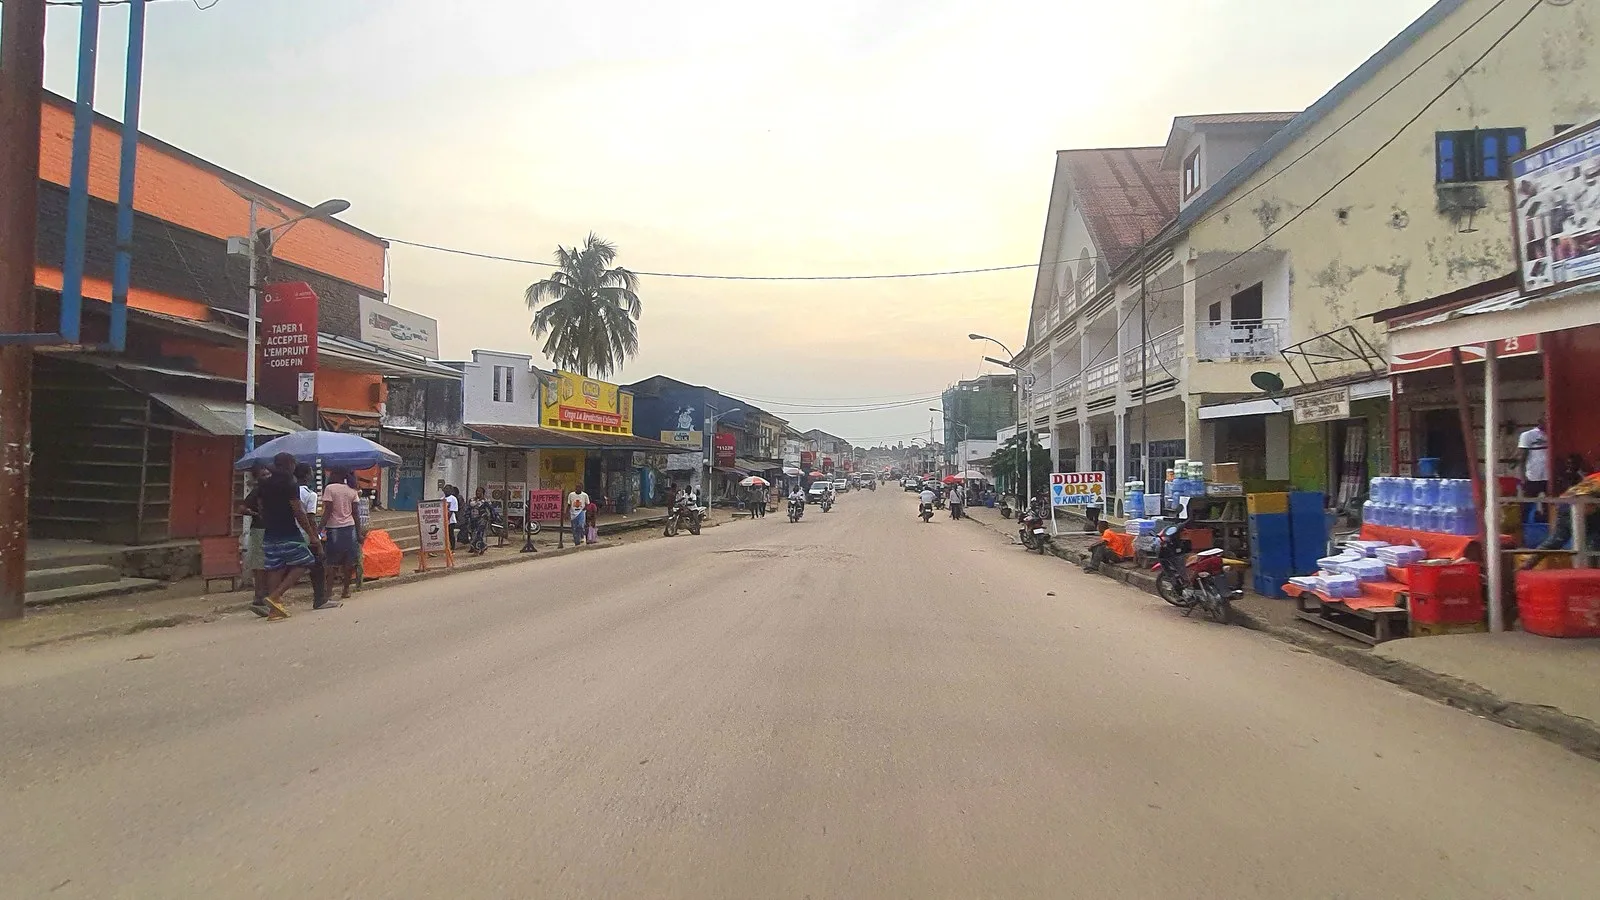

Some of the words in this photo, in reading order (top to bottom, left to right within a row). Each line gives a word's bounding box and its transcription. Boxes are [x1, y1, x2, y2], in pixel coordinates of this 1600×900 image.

[272, 324, 297, 334] TAPER
[298, 323, 303, 332] 1
[266, 334, 308, 346] ACCEPTER
[1504, 336, 1519, 351] 23
[264, 346, 309, 357] L'EMPRUNT
[270, 359, 290, 367] CODE
[290, 358, 303, 367] PIN
[1052, 473, 1103, 484] DIDIER
[1064, 484, 1089, 495] OR
[532, 493, 561, 502] PAPETERIE
[1062, 495, 1094, 504] KAWENDE
[531, 511, 561, 519] SERVICE
